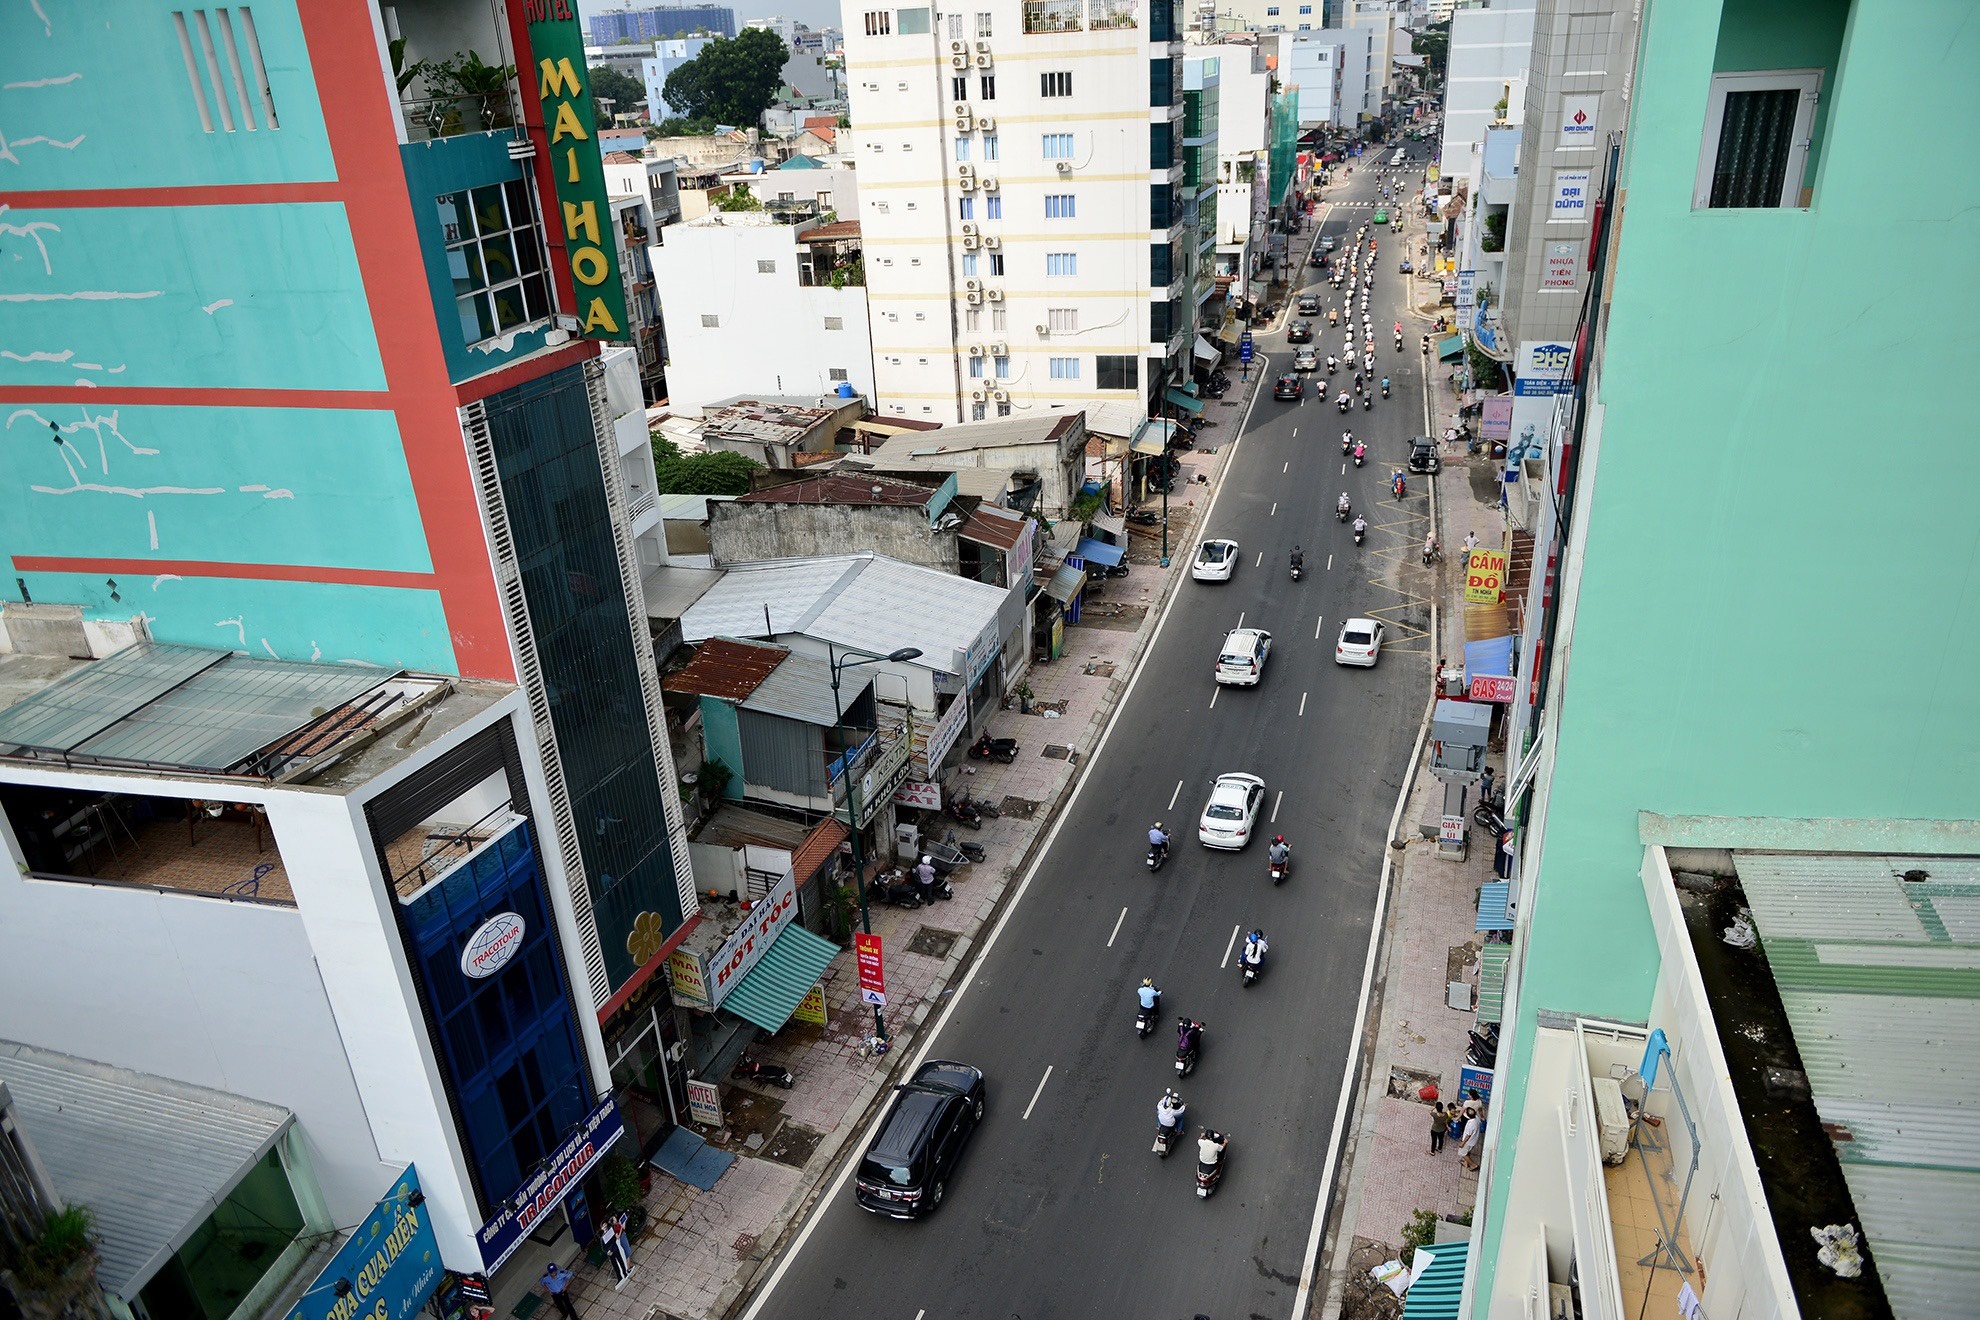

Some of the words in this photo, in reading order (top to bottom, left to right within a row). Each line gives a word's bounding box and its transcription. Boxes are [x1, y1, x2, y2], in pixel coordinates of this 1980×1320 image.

[540, 57, 588, 183] MAI
[562, 200, 620, 335] HOA
[1470, 550, 1504, 570] CẦM
[1468, 572, 1498, 588] ĐỒ
[1472, 678, 1496, 698] GAS
[472, 926, 520, 968] TRACOTOUR
[672, 958, 700, 974] MAI
[675, 971, 702, 987] HOA
[688, 1085, 716, 1105] HOTEL
[691, 1101, 702, 1109] MAI
[704, 1104, 717, 1112] HOA
[516, 1142, 595, 1230] TRACOTOUR
[356, 1250, 389, 1297] CUA
[384, 1204, 420, 1261] BIỂN
